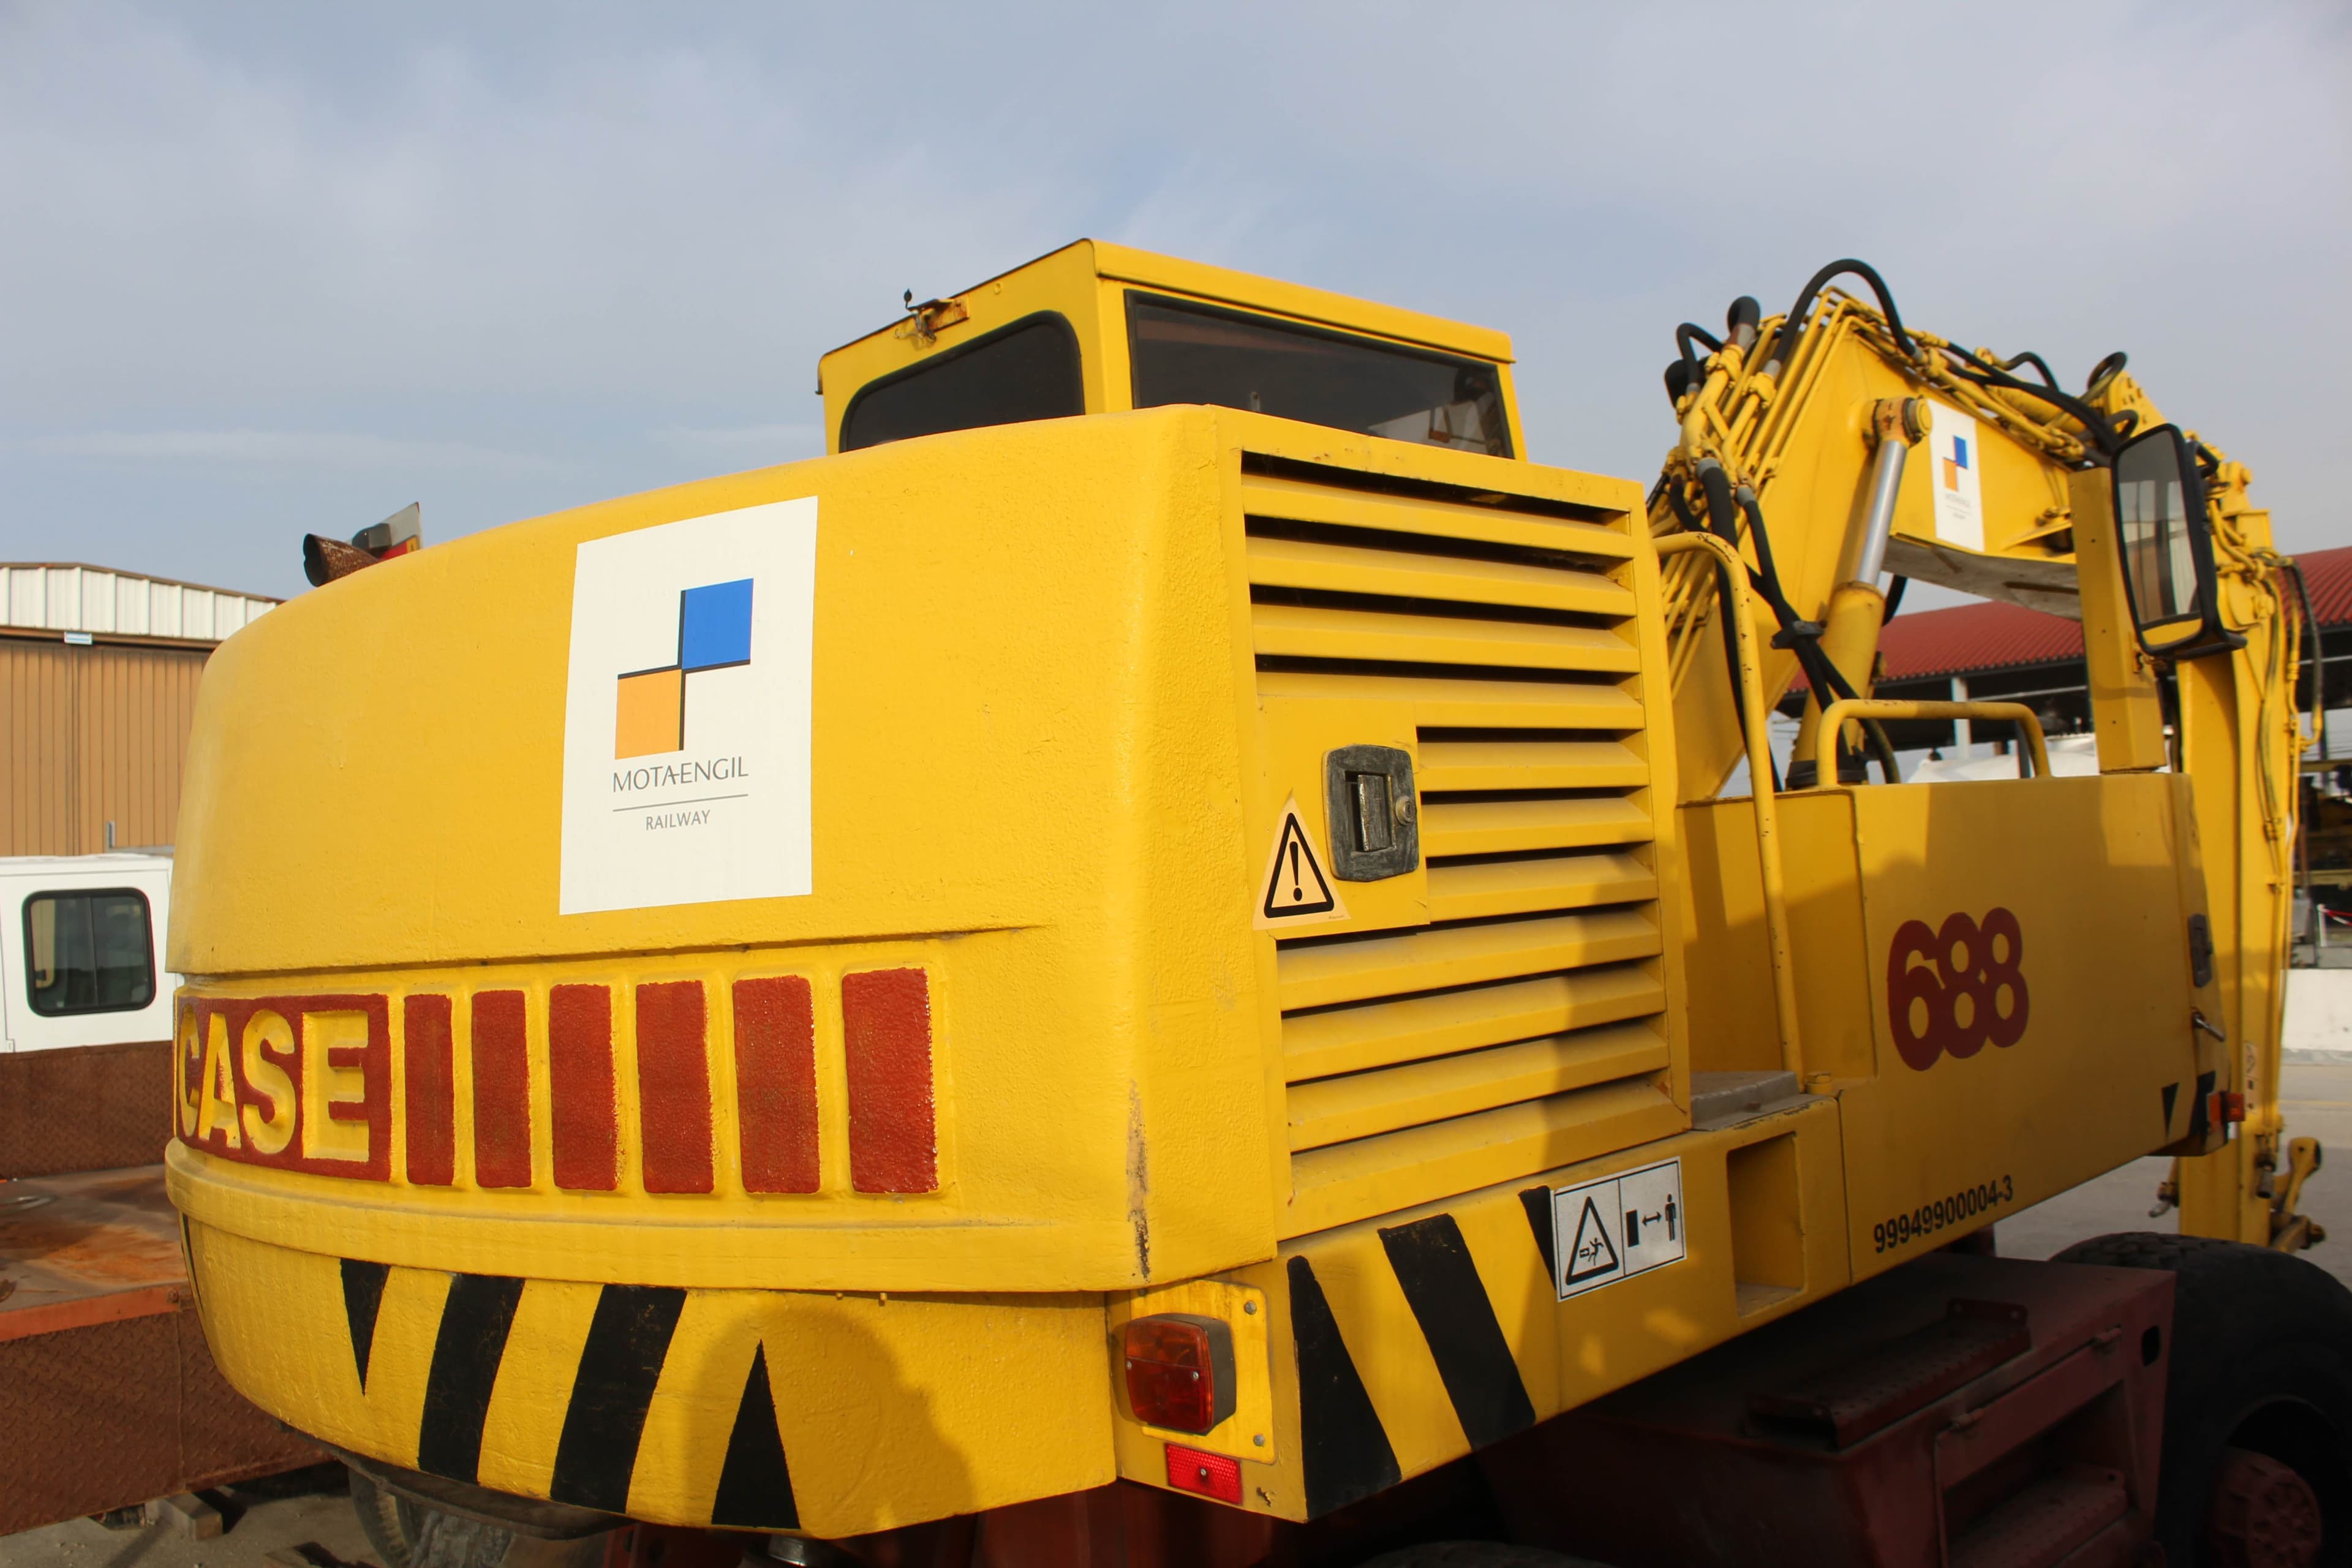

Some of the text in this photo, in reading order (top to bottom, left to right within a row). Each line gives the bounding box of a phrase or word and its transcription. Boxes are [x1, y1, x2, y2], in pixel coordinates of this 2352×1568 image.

[646, 810, 710, 830] RAILWAY
[1887, 907, 2029, 1071] 688
[179, 1005, 369, 1163] CASE
[1874, 1174, 2013, 1253] 99949900004-3
